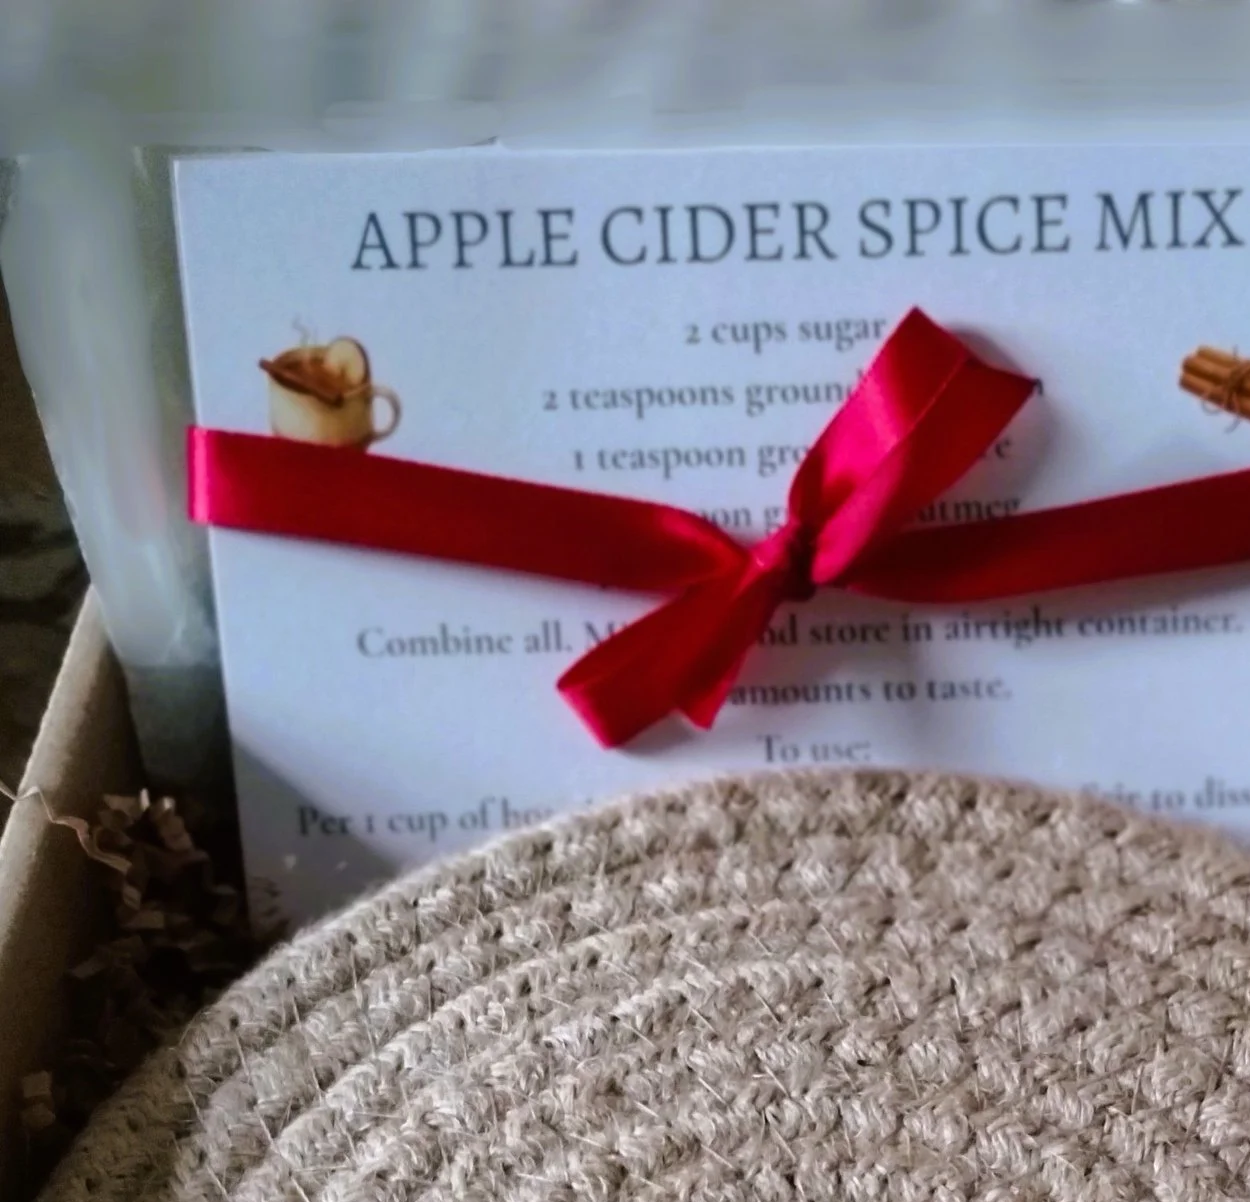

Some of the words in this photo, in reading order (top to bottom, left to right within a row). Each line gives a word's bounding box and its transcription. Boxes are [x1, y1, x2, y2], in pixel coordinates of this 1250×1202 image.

[351, 207, 579, 271] APPLE
[600, 201, 839, 266] CIDER
[858, 193, 1072, 258] SPICE
[1094, 188, 1246, 251] MIX
[685, 324, 702, 344] 2
[711, 320, 788, 354] cups
[799, 318, 887, 351] sugar
[542, 389, 559, 410] 2
[570, 382, 735, 419] teaspoons
[574, 448, 585, 471] 1
[597, 445, 747, 480] teaspoon
[356, 622, 514, 659] Combine
[525, 619, 573, 654] all.
[809, 622, 889, 645] store
[900, 611, 934, 643] in
[945, 604, 1064, 648] airtight
[1076, 607, 1244, 638] container.
[731, 680, 872, 706] amounts
[883, 679, 915, 701] to
[926, 677, 1013, 701] taste.
[756, 734, 801, 763] To
[811, 739, 873, 763] use:
[297, 804, 350, 838] Per
[387, 808, 449, 842] cup
[457, 796, 497, 831] of
[1151, 788, 1187, 811] to
